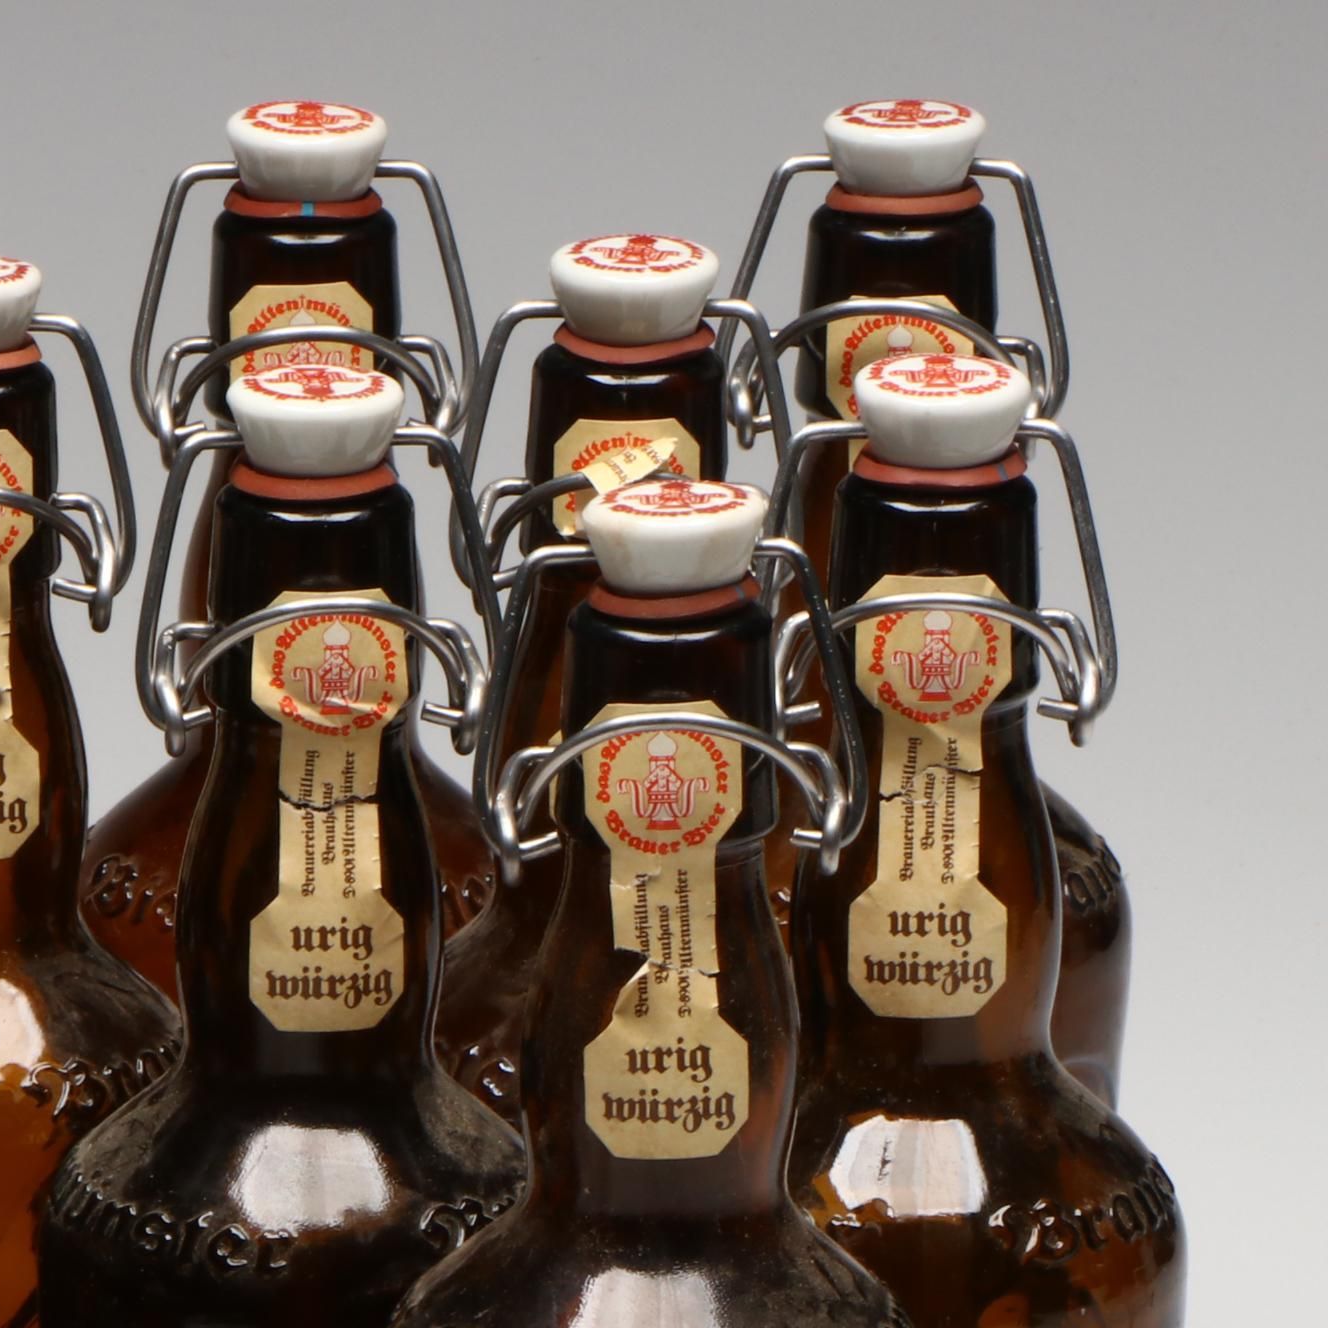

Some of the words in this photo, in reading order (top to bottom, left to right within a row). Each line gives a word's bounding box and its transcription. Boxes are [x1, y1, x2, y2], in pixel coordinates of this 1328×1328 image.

[289, 916, 374, 961] urig
[887, 903, 972, 948] urig
[265, 963, 394, 1010] würzig
[863, 950, 994, 996] würzig
[625, 1037, 713, 1083] urig
[601, 1086, 736, 1133] würzig
